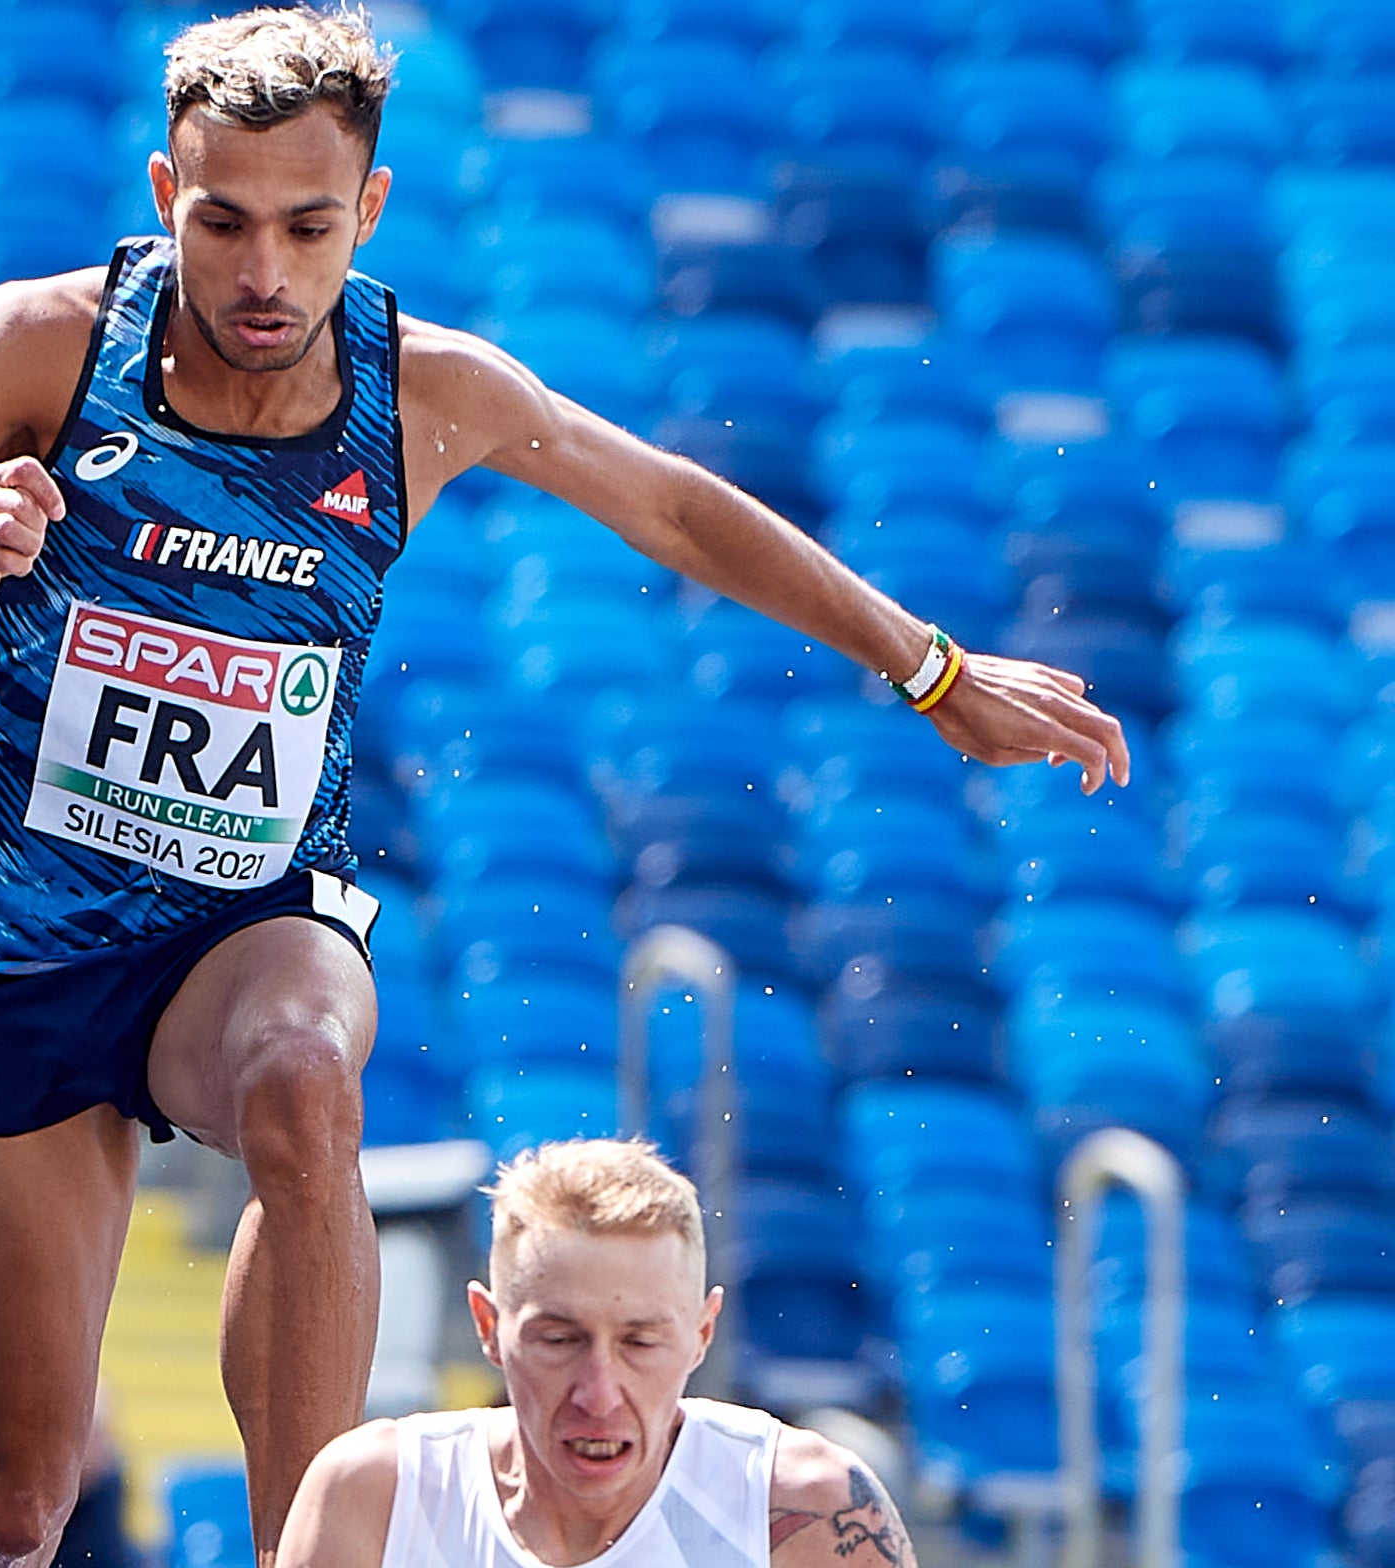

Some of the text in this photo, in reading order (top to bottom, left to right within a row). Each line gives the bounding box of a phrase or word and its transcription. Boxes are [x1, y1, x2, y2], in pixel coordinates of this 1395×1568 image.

[323, 490, 370, 515] MAIF
[159, 528, 325, 587] FRANCE
[74, 617, 274, 704] SPAR
[86, 684, 280, 808] FRA
[92, 781, 102, 798] I
[106, 784, 163, 819] RUN
[64, 802, 267, 882] SILESIA 2021
